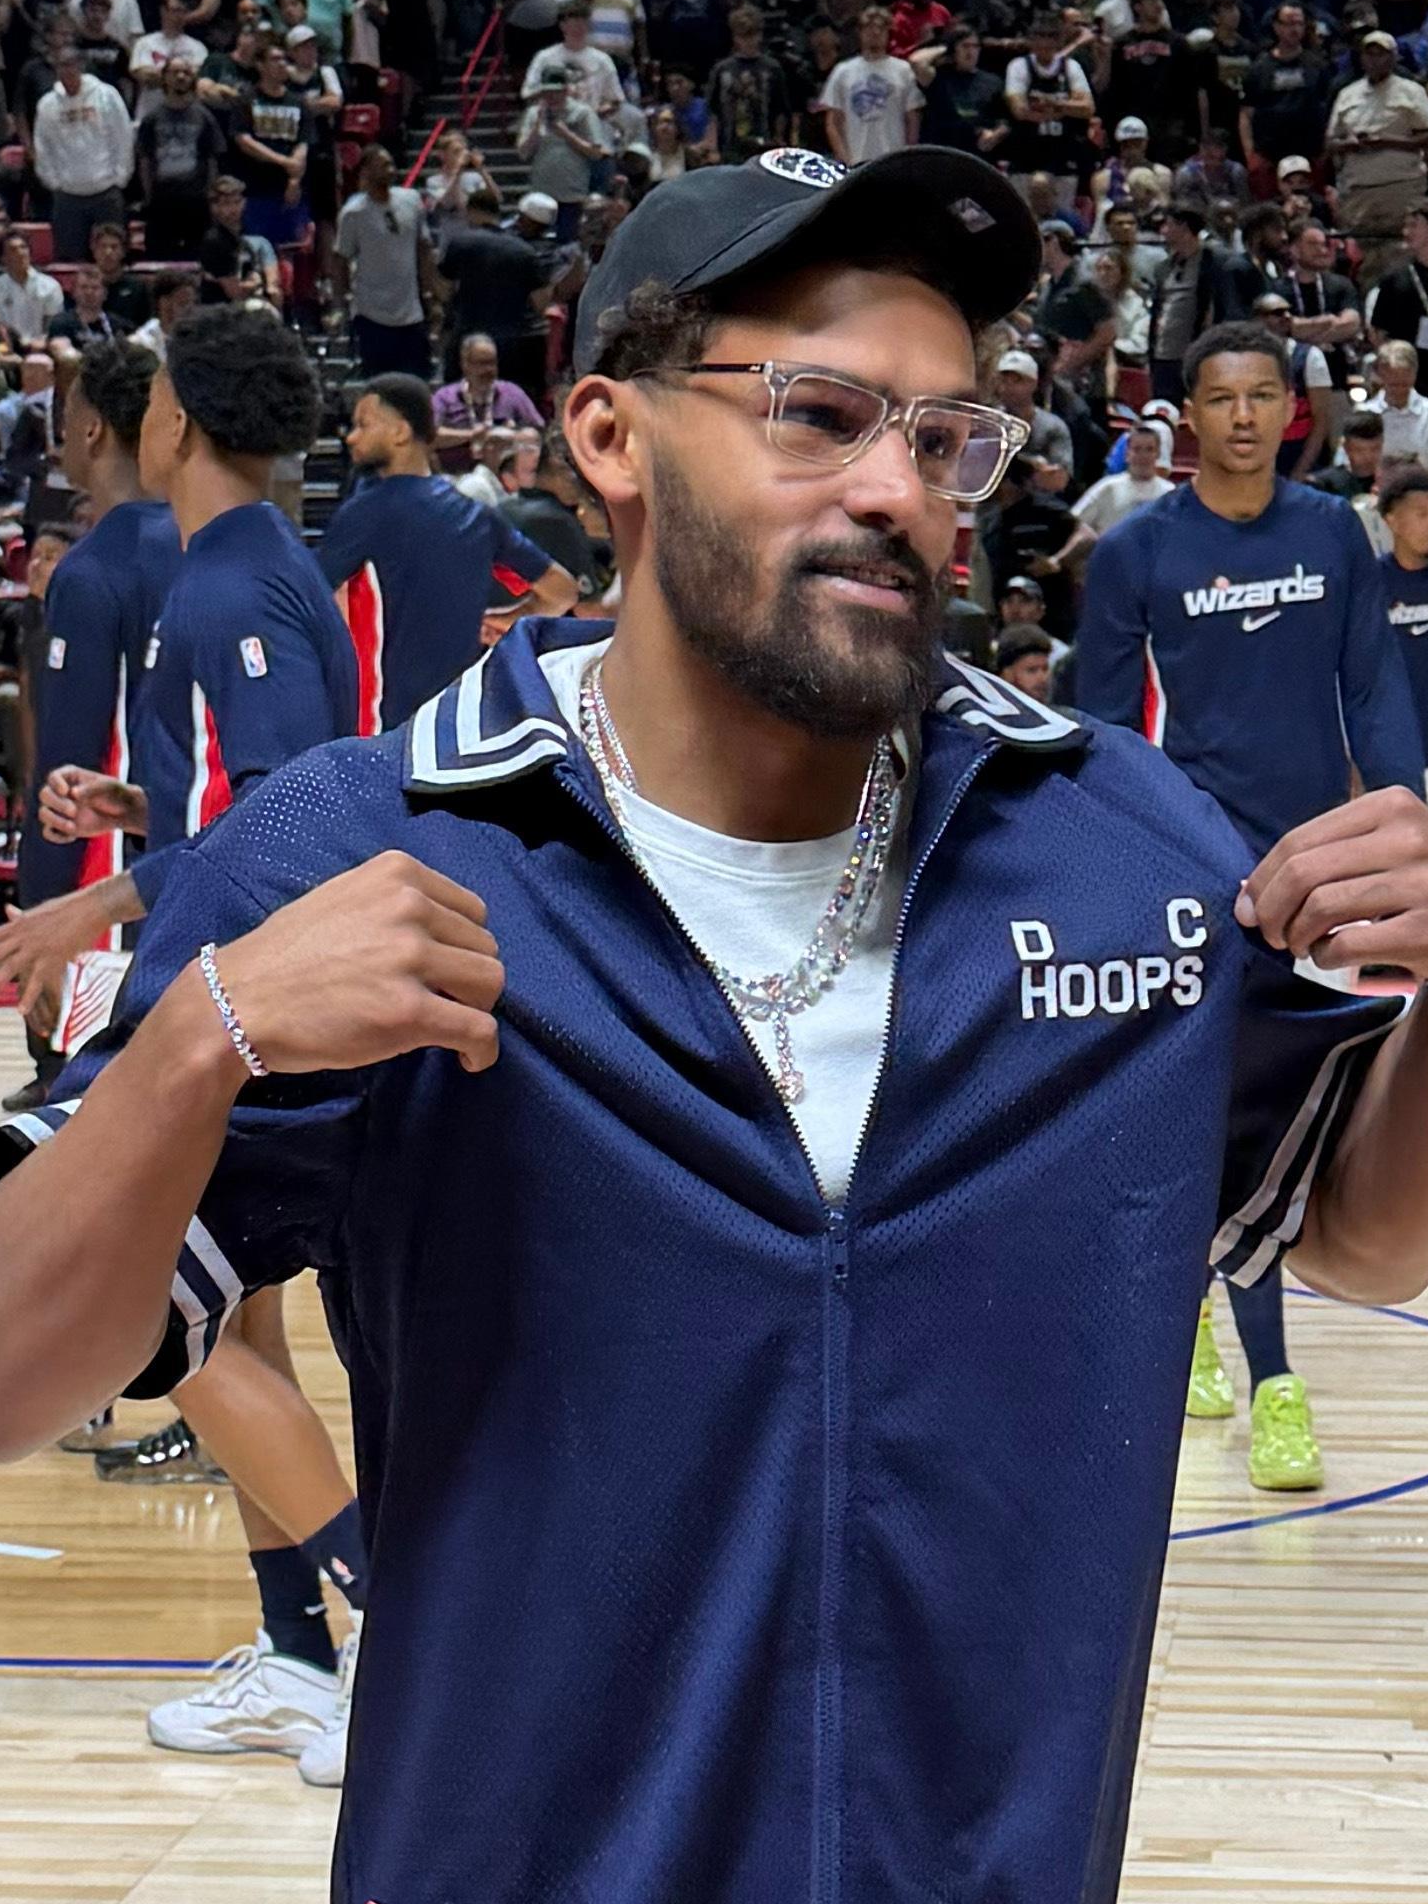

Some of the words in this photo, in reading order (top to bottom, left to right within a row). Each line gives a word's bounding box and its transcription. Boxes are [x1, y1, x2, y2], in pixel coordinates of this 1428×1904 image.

[1182, 563, 1326, 617] wizards
[1010, 920, 1056, 962] D
[1166, 897, 1208, 949] C
[1020, 955, 1205, 1020] HOOPS
